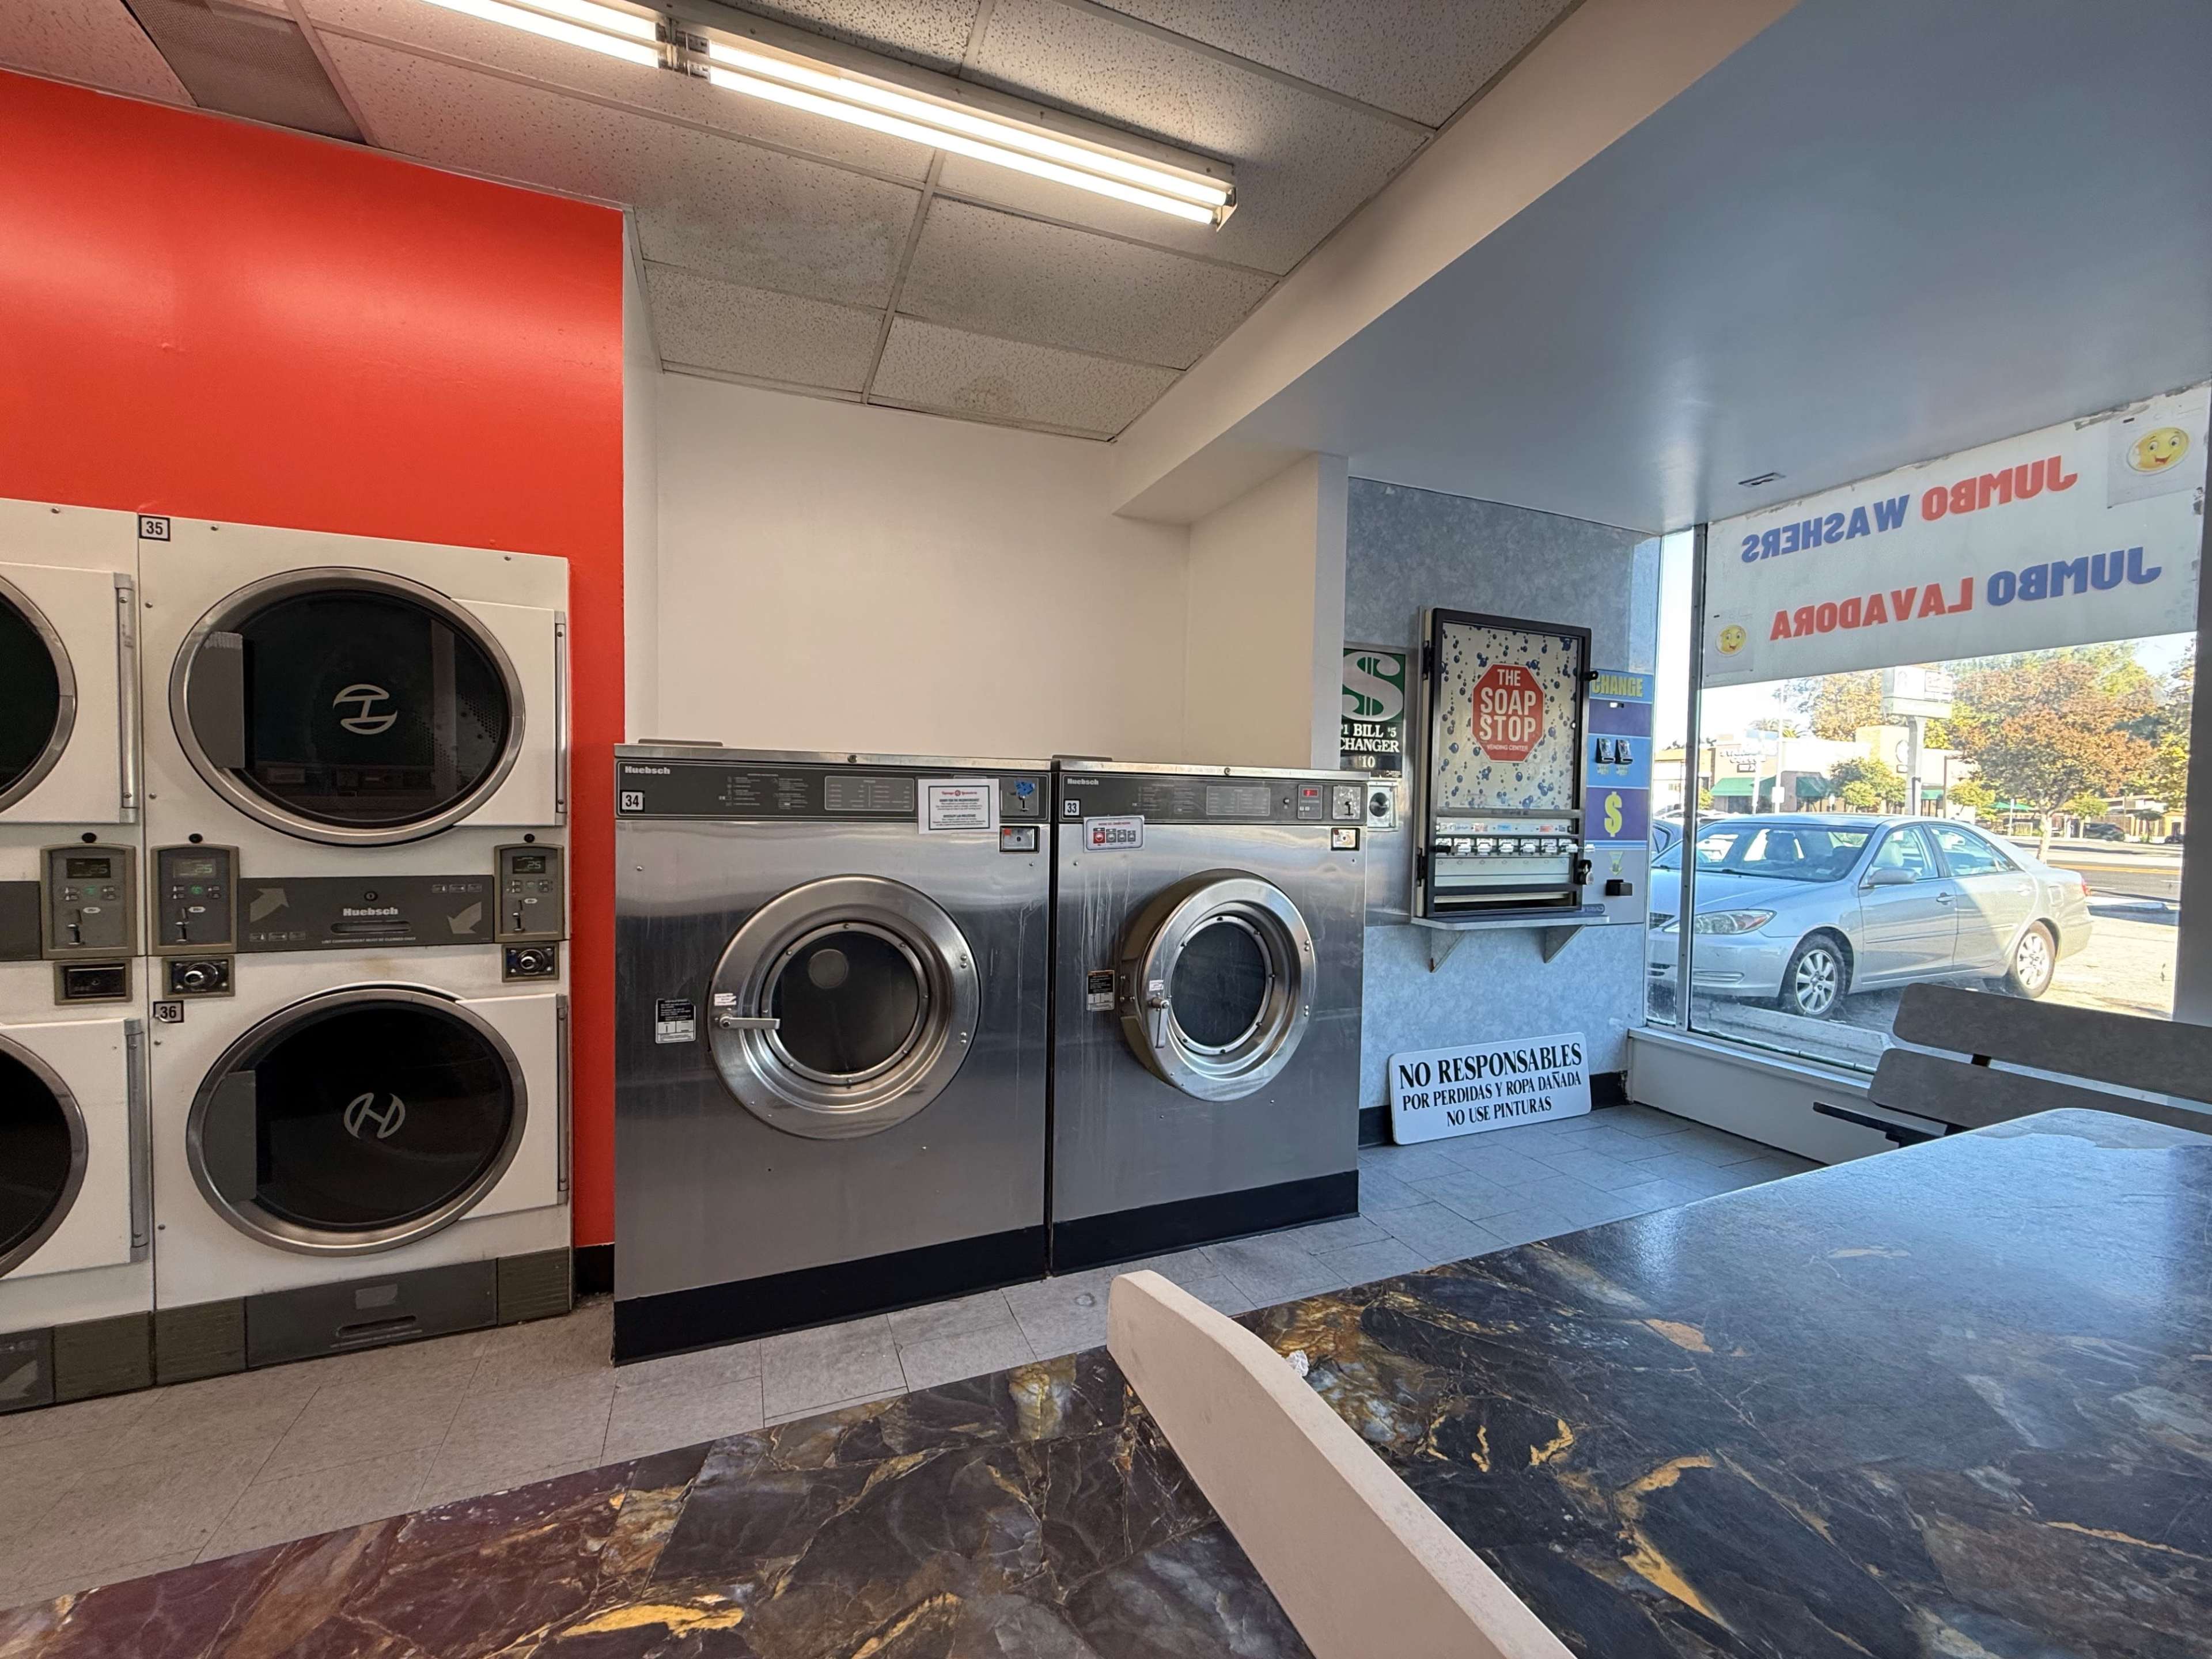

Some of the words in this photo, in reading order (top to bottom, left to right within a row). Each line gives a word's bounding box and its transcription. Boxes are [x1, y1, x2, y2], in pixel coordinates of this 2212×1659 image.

[146, 521, 163, 535] 35
[1497, 669, 1521, 686] THE
[1592, 675, 1643, 697] CHANGE
[1480, 687, 1536, 715] SOAP
[1353, 724, 1384, 738] BILL
[1479, 714, 1536, 742] STOP
[625, 766, 671, 775] Huebsch
[625, 794, 639, 808] 34
[1067, 803, 1077, 813] 33
[343, 907, 399, 916] Huebsch
[160, 1005, 177, 1019] 36
[1399, 1062, 1431, 1089] NO
[1438, 1043, 1582, 1084] RESPONSABLES
[1403, 1093, 1430, 1111] POR
[1433, 1084, 1492, 1107] PERDIDAS
[1495, 1082, 1503, 1097] Y
[1506, 1077, 1535, 1096] ROPA
[1539, 1071, 1582, 1092] DAÑADA
[1446, 1109, 1465, 1127] NO
[1469, 1105, 1491, 1124] USE
[1494, 1096, 1552, 1119] PINTURAS
